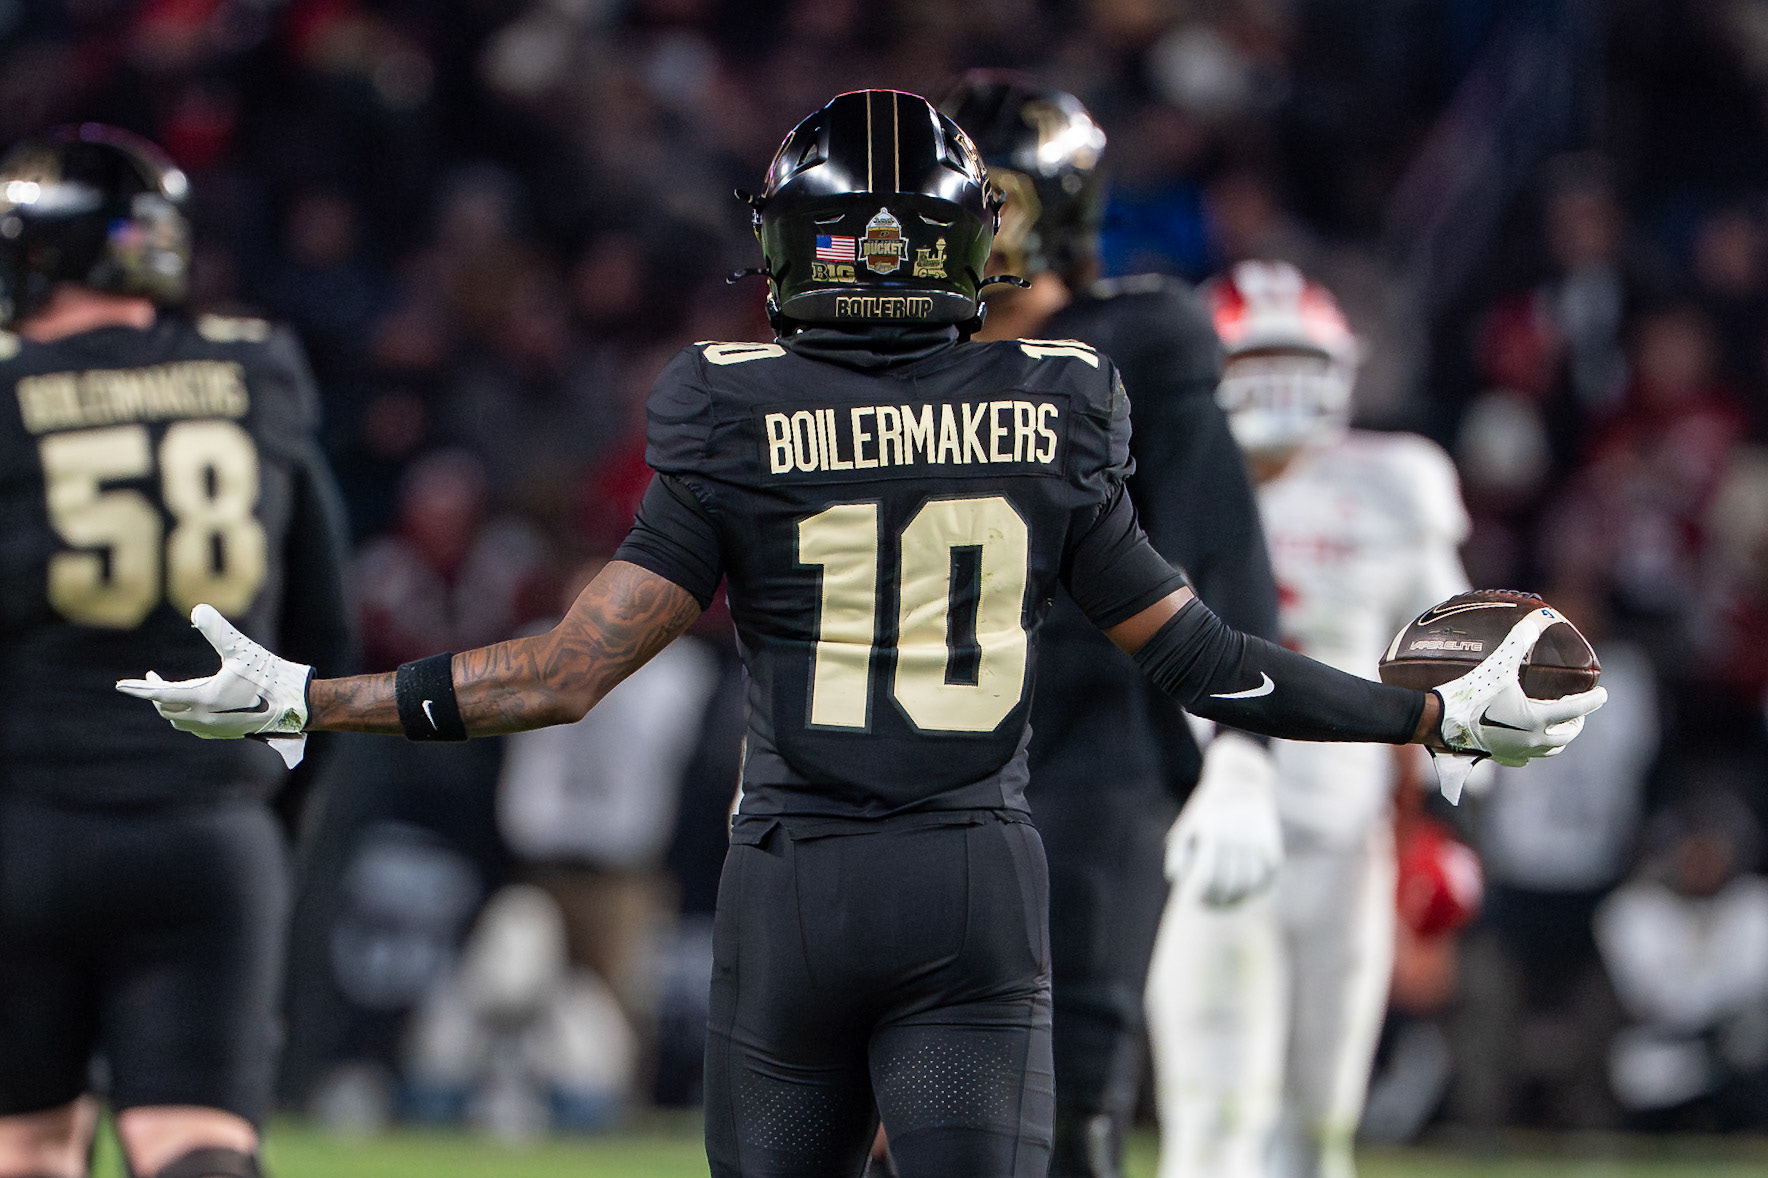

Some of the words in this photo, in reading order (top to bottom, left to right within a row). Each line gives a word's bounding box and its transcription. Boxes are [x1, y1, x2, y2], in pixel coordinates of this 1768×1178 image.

[835, 297, 906, 319] BOILER
[906, 297, 934, 319] UP
[764, 400, 1060, 475] BOILERMAKERS
[40, 420, 267, 630] 58
[796, 494, 1030, 734] 10
[1443, 640, 1484, 652] ELITE
